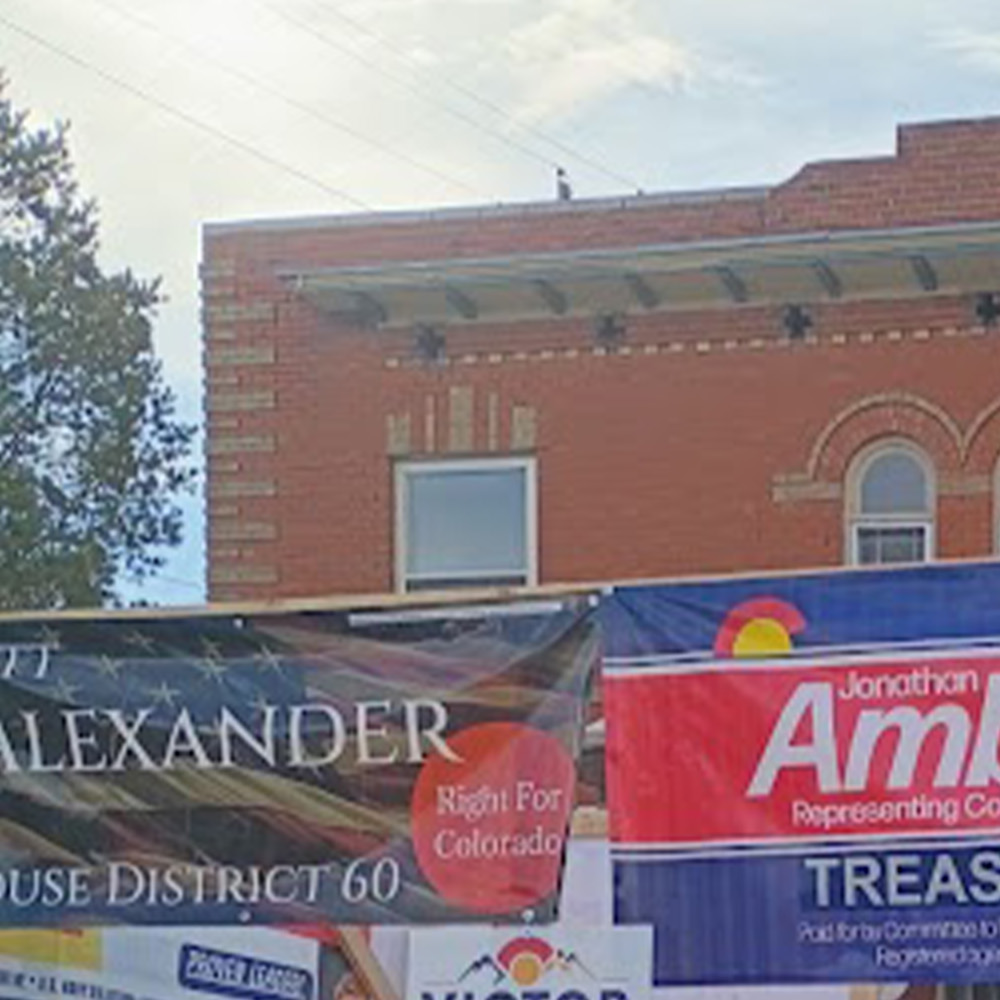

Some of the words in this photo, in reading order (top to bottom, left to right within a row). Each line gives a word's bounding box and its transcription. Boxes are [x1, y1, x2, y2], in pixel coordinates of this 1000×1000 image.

[838, 666, 979, 700] Jonathan
[436, 784, 508, 822] Right
[516, 780, 563, 812] For
[792, 793, 959, 829] Representing
[434, 826, 561, 859] Colorado
[107, 860, 330, 907] DISTRICT
[341, 857, 400, 901] 60
